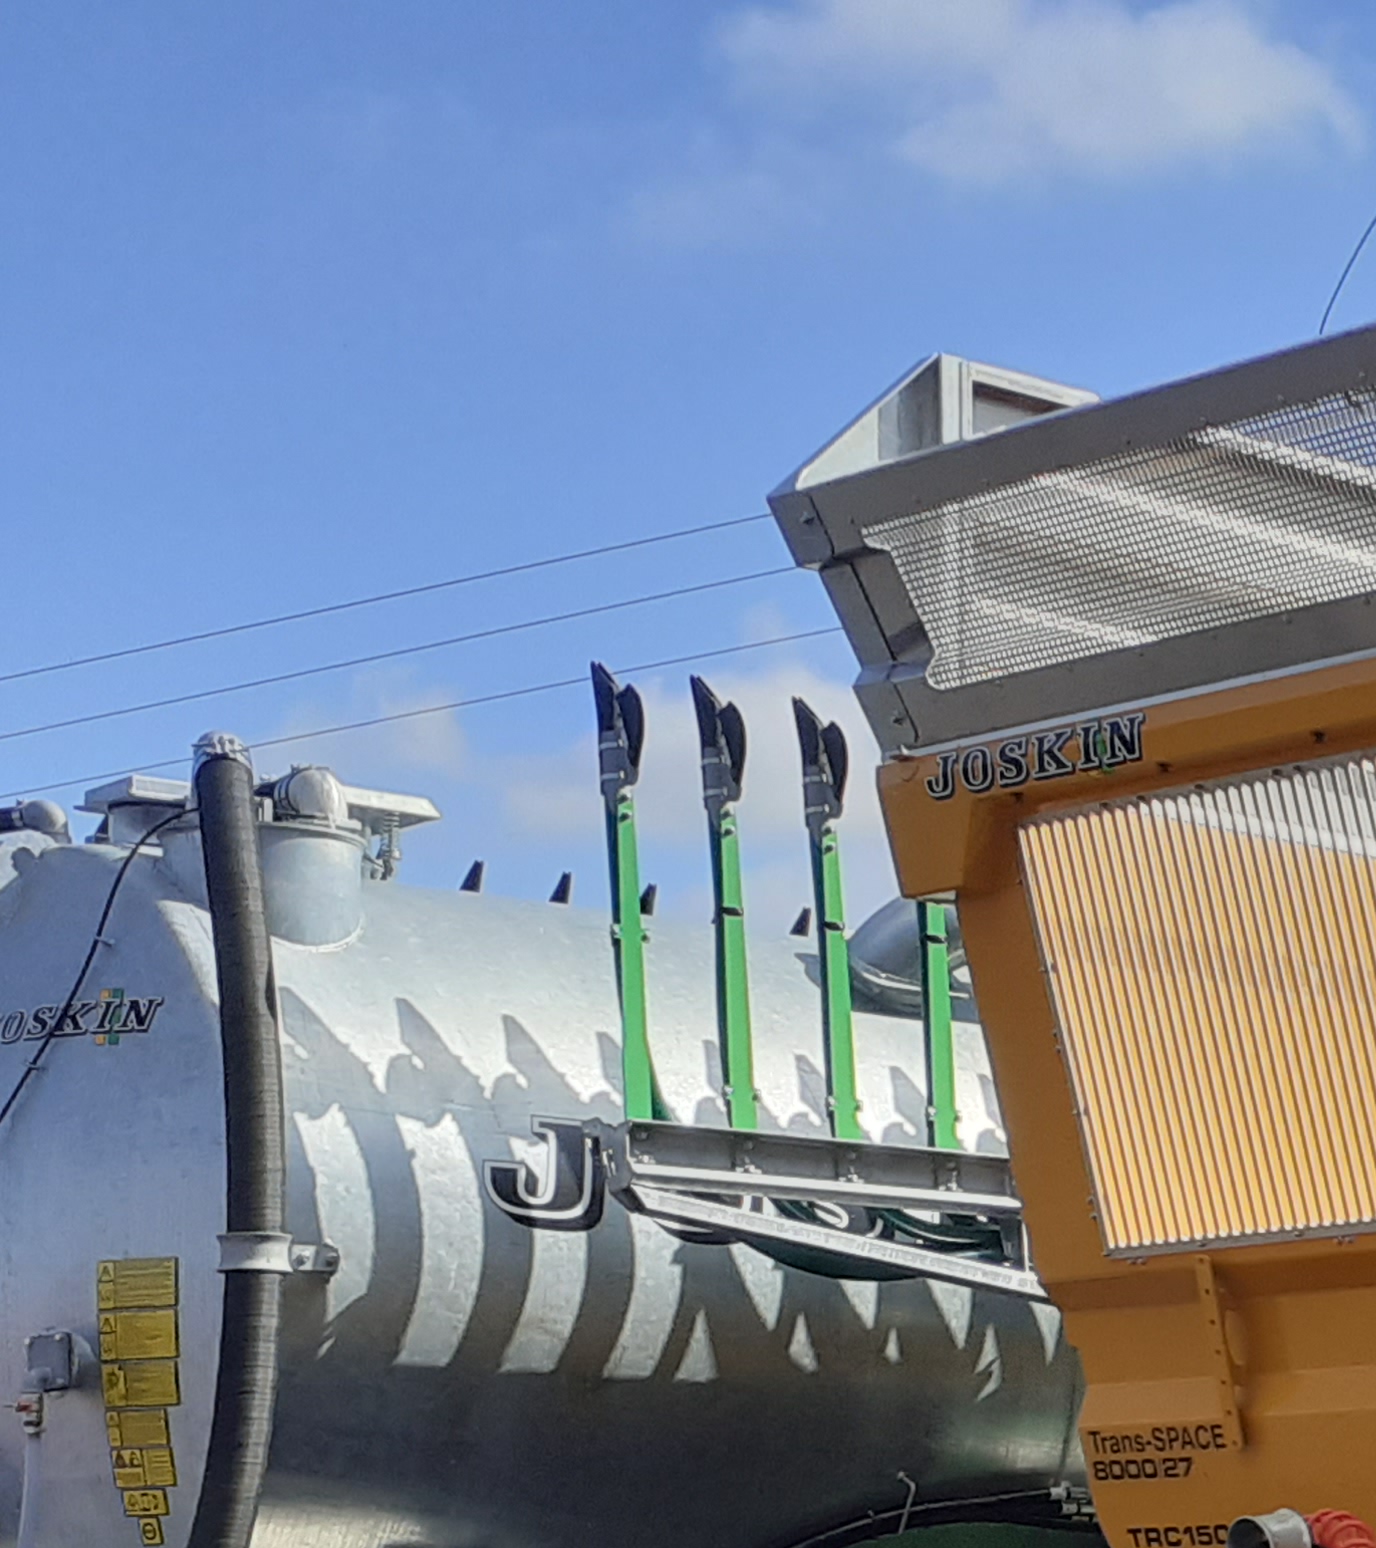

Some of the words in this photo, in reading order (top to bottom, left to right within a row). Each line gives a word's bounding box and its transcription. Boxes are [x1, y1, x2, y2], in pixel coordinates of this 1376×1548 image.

[925, 712, 1146, 801] JOSKIN
[0, 997, 165, 1045] OSKIN
[1087, 1424, 1227, 1454] Trans-SPACE
